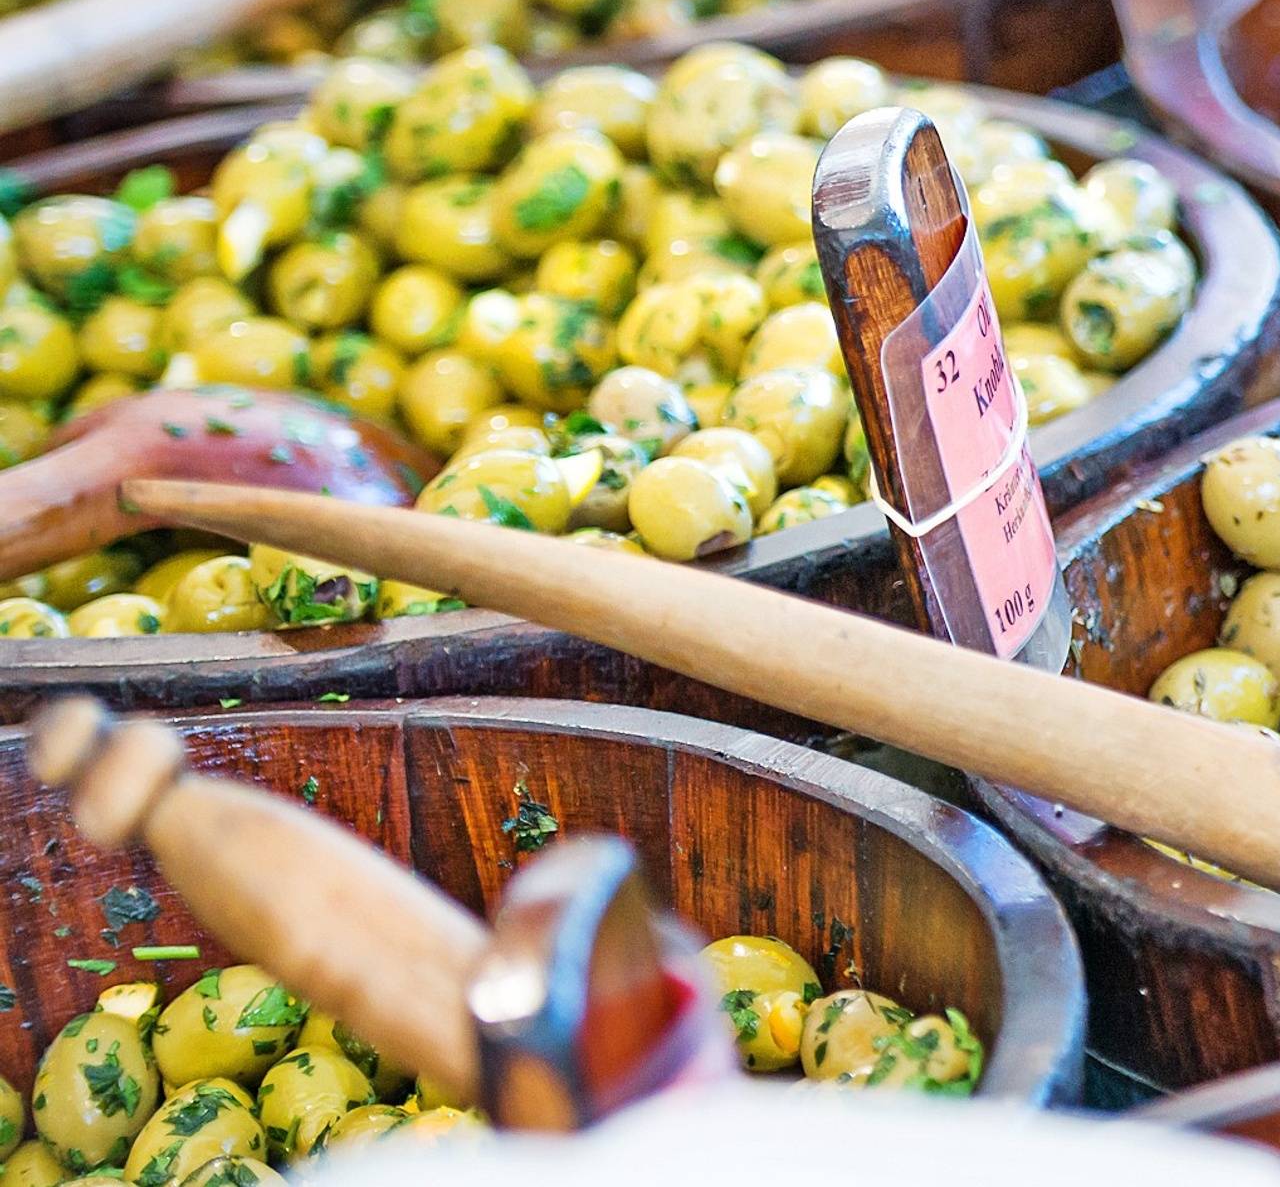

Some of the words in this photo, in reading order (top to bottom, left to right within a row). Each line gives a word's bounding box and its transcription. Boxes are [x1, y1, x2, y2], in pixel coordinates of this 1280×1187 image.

[934, 349, 960, 394] 32
[994, 590, 1024, 634] 100
[1024, 581, 1035, 613] g
